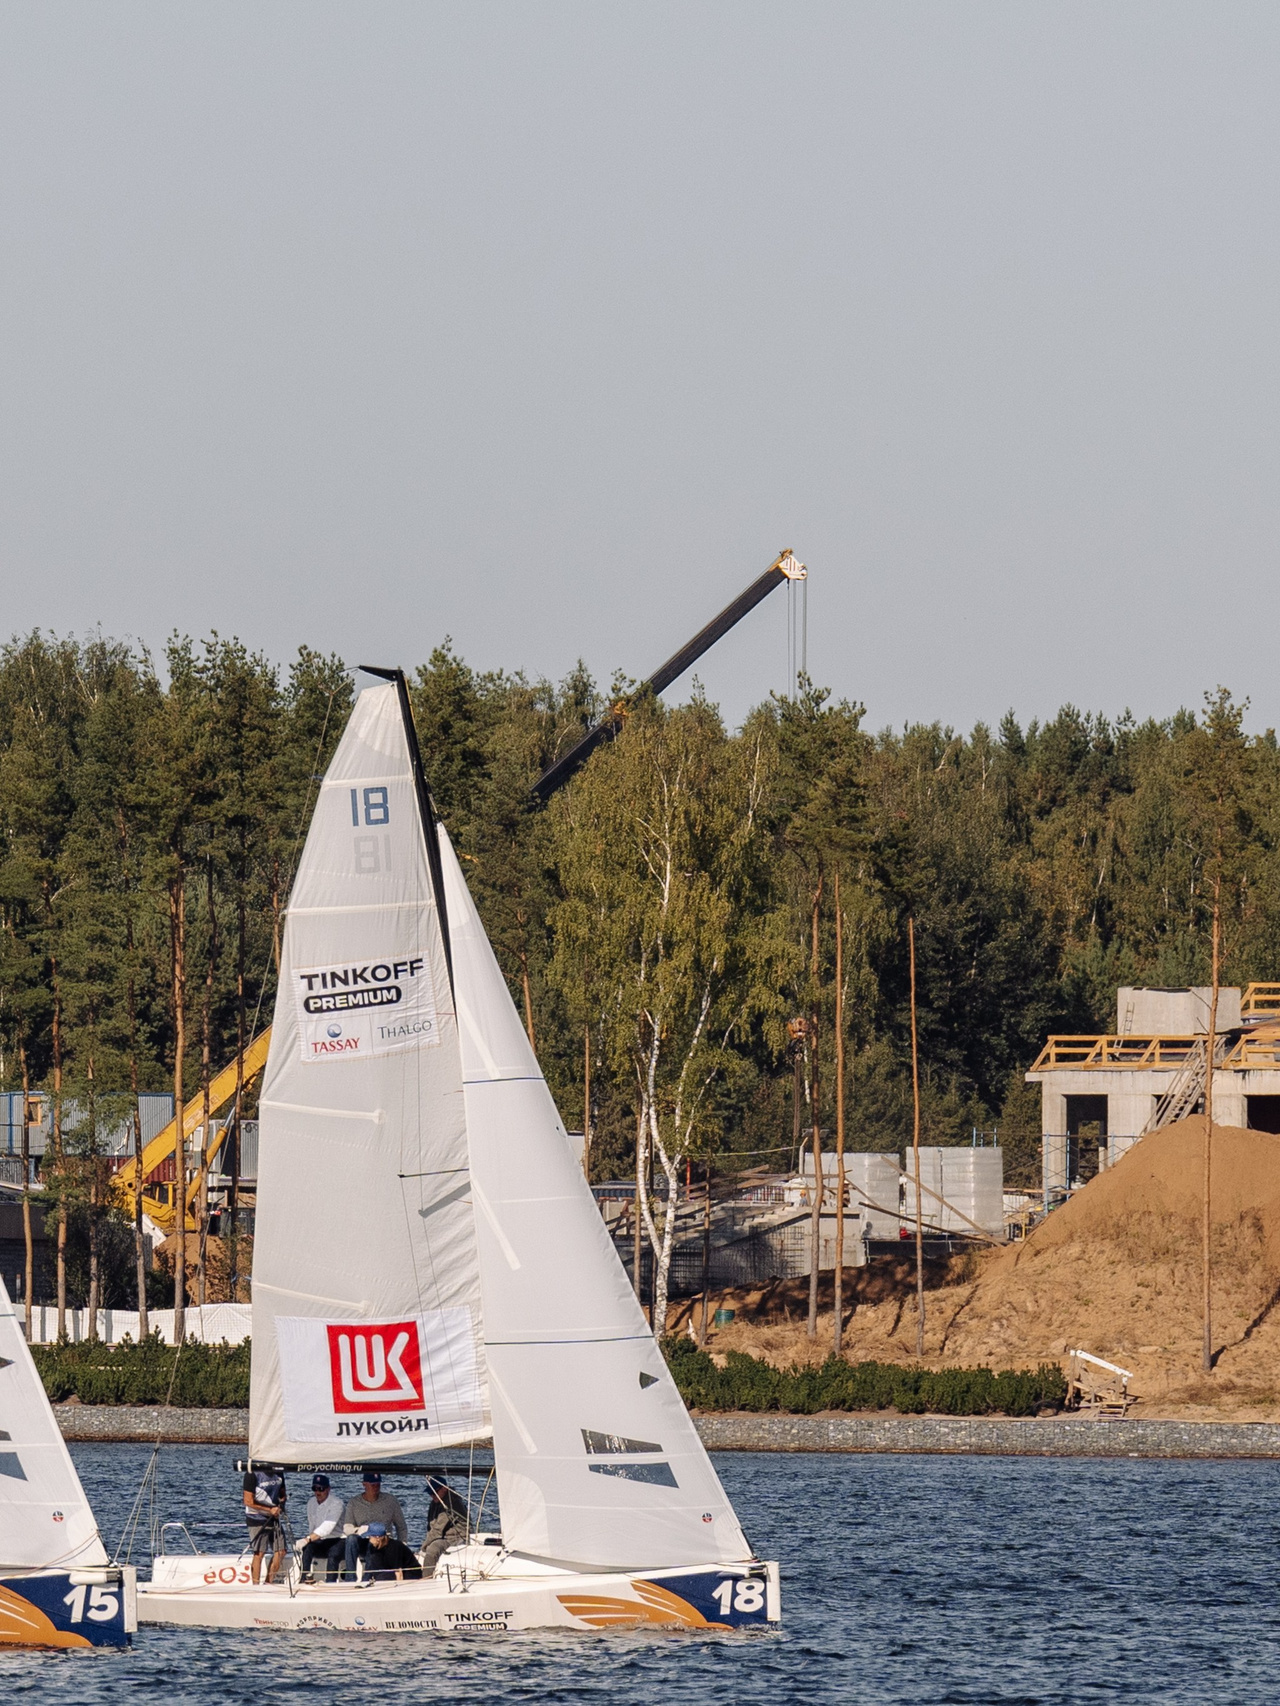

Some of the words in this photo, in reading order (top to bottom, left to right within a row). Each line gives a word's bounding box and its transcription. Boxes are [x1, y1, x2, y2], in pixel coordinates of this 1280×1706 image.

[350, 786, 389, 826] 18
[300, 958, 424, 991] TINKOFF
[309, 987, 398, 1012] PREMIUM
[311, 1037, 360, 1053] TASSAY
[338, 1331, 419, 1402] LUK
[336, 1416, 429, 1436] ЛУКОЙЛ
[297, 1463, 363, 1472] pro-yachting.ru
[63, 1582, 119, 1622] 15
[711, 1577, 766, 1615] 18
[444, 1611, 513, 1622] TINKOFF
